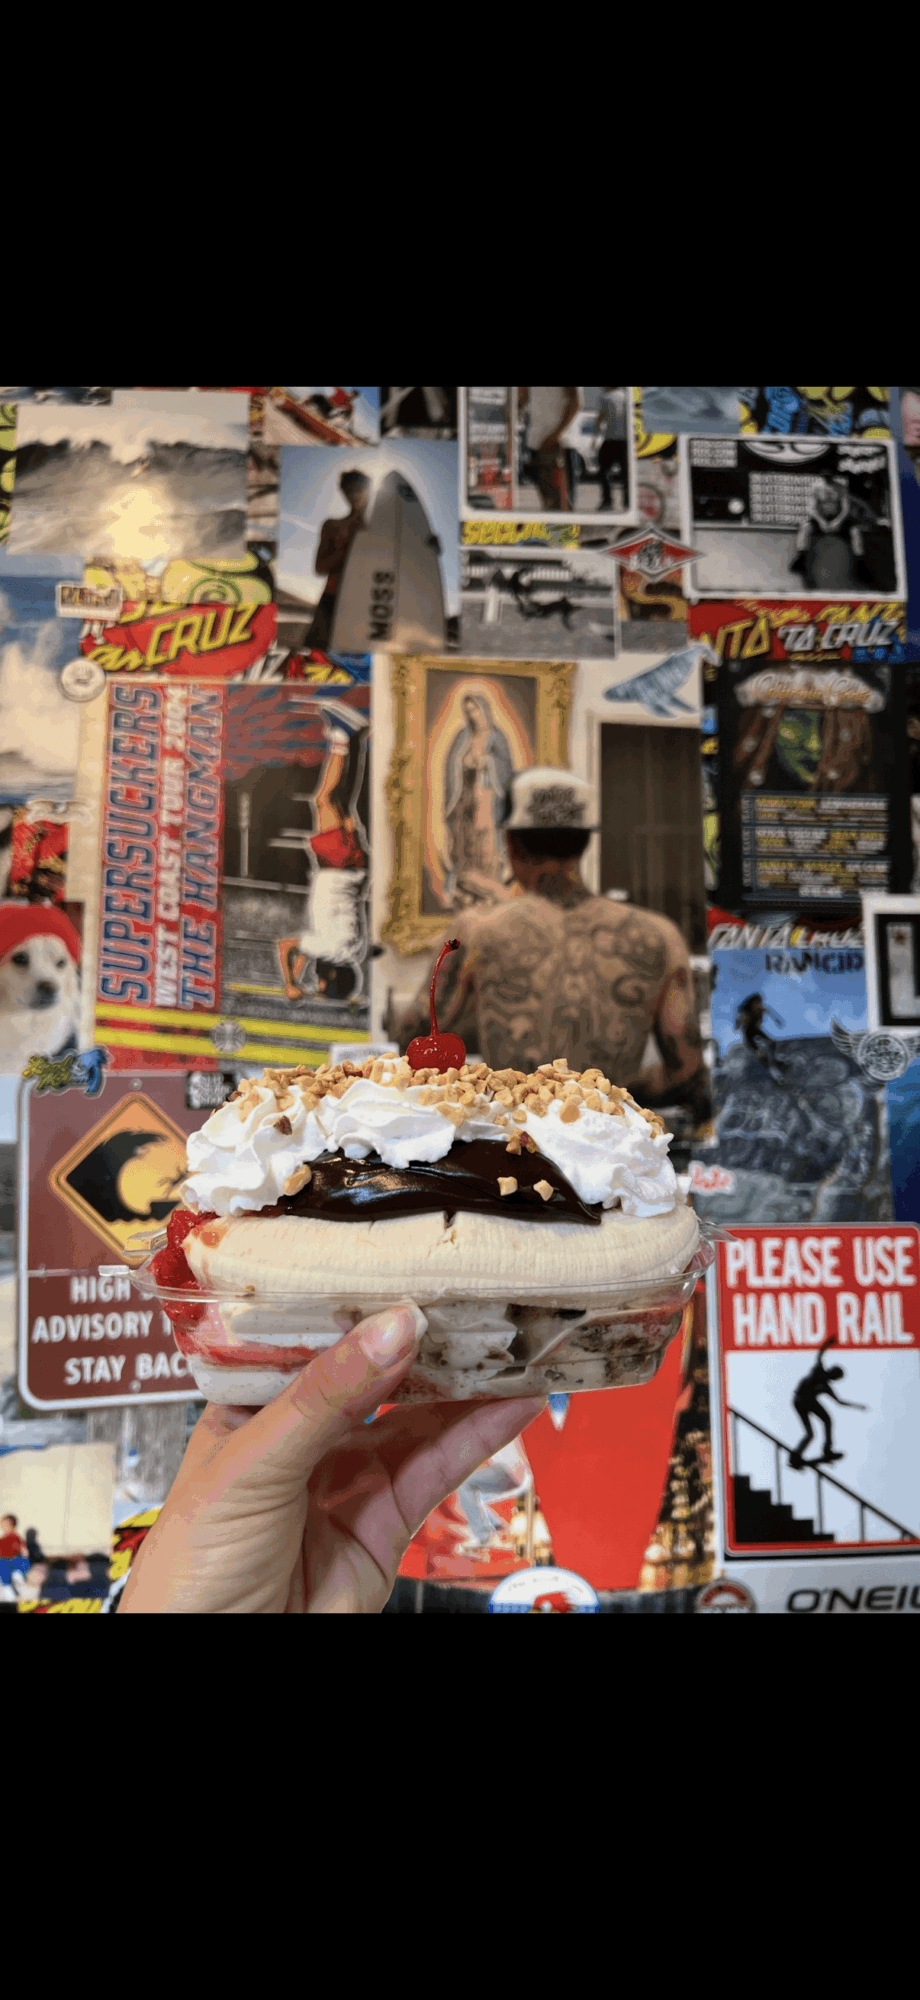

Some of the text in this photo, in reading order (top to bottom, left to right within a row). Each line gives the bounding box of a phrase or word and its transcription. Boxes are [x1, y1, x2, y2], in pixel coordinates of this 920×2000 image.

[369, 571, 396, 641] MOSS
[145, 600, 261, 668] CRUZ
[821, 618, 900, 651] CRUZ
[100, 684, 161, 1003] SUPERSUCKERS
[155, 685, 188, 1007] WEST COAST TOUR 2004
[180, 683, 223, 1008] THE HANGMAN
[764, 952, 864, 975] RANCID
[726, 1236, 917, 1289] PLEASE USE
[70, 1276, 132, 1304] HIGH
[31, 1310, 154, 1344] ADVISORY
[732, 1291, 915, 1347] HAND RAIL
[64, 1354, 126, 1386] STAY
